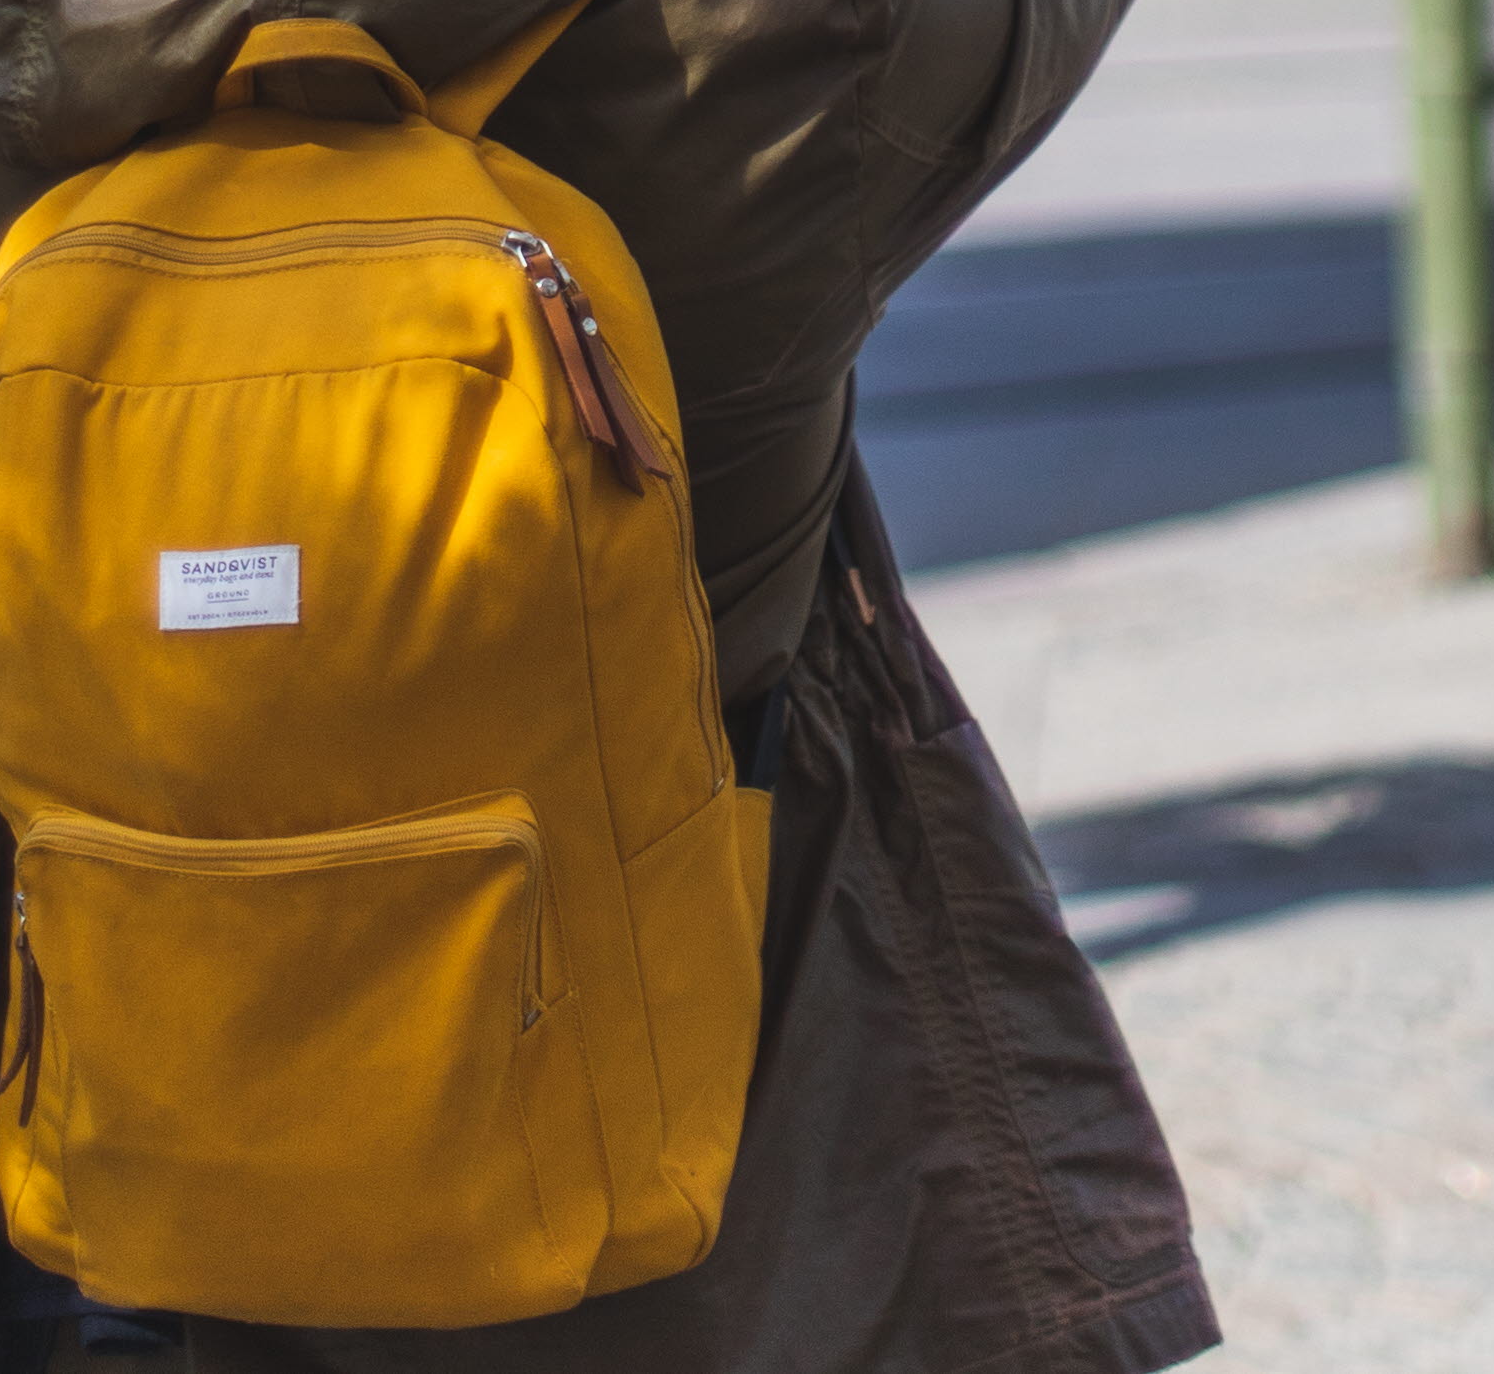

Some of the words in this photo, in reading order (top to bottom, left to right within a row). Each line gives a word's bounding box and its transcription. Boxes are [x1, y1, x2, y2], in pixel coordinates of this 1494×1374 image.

[182, 556, 278, 575] SANDQVIST
[239, 572, 253, 580] and
[207, 590, 250, 599] GROUND
